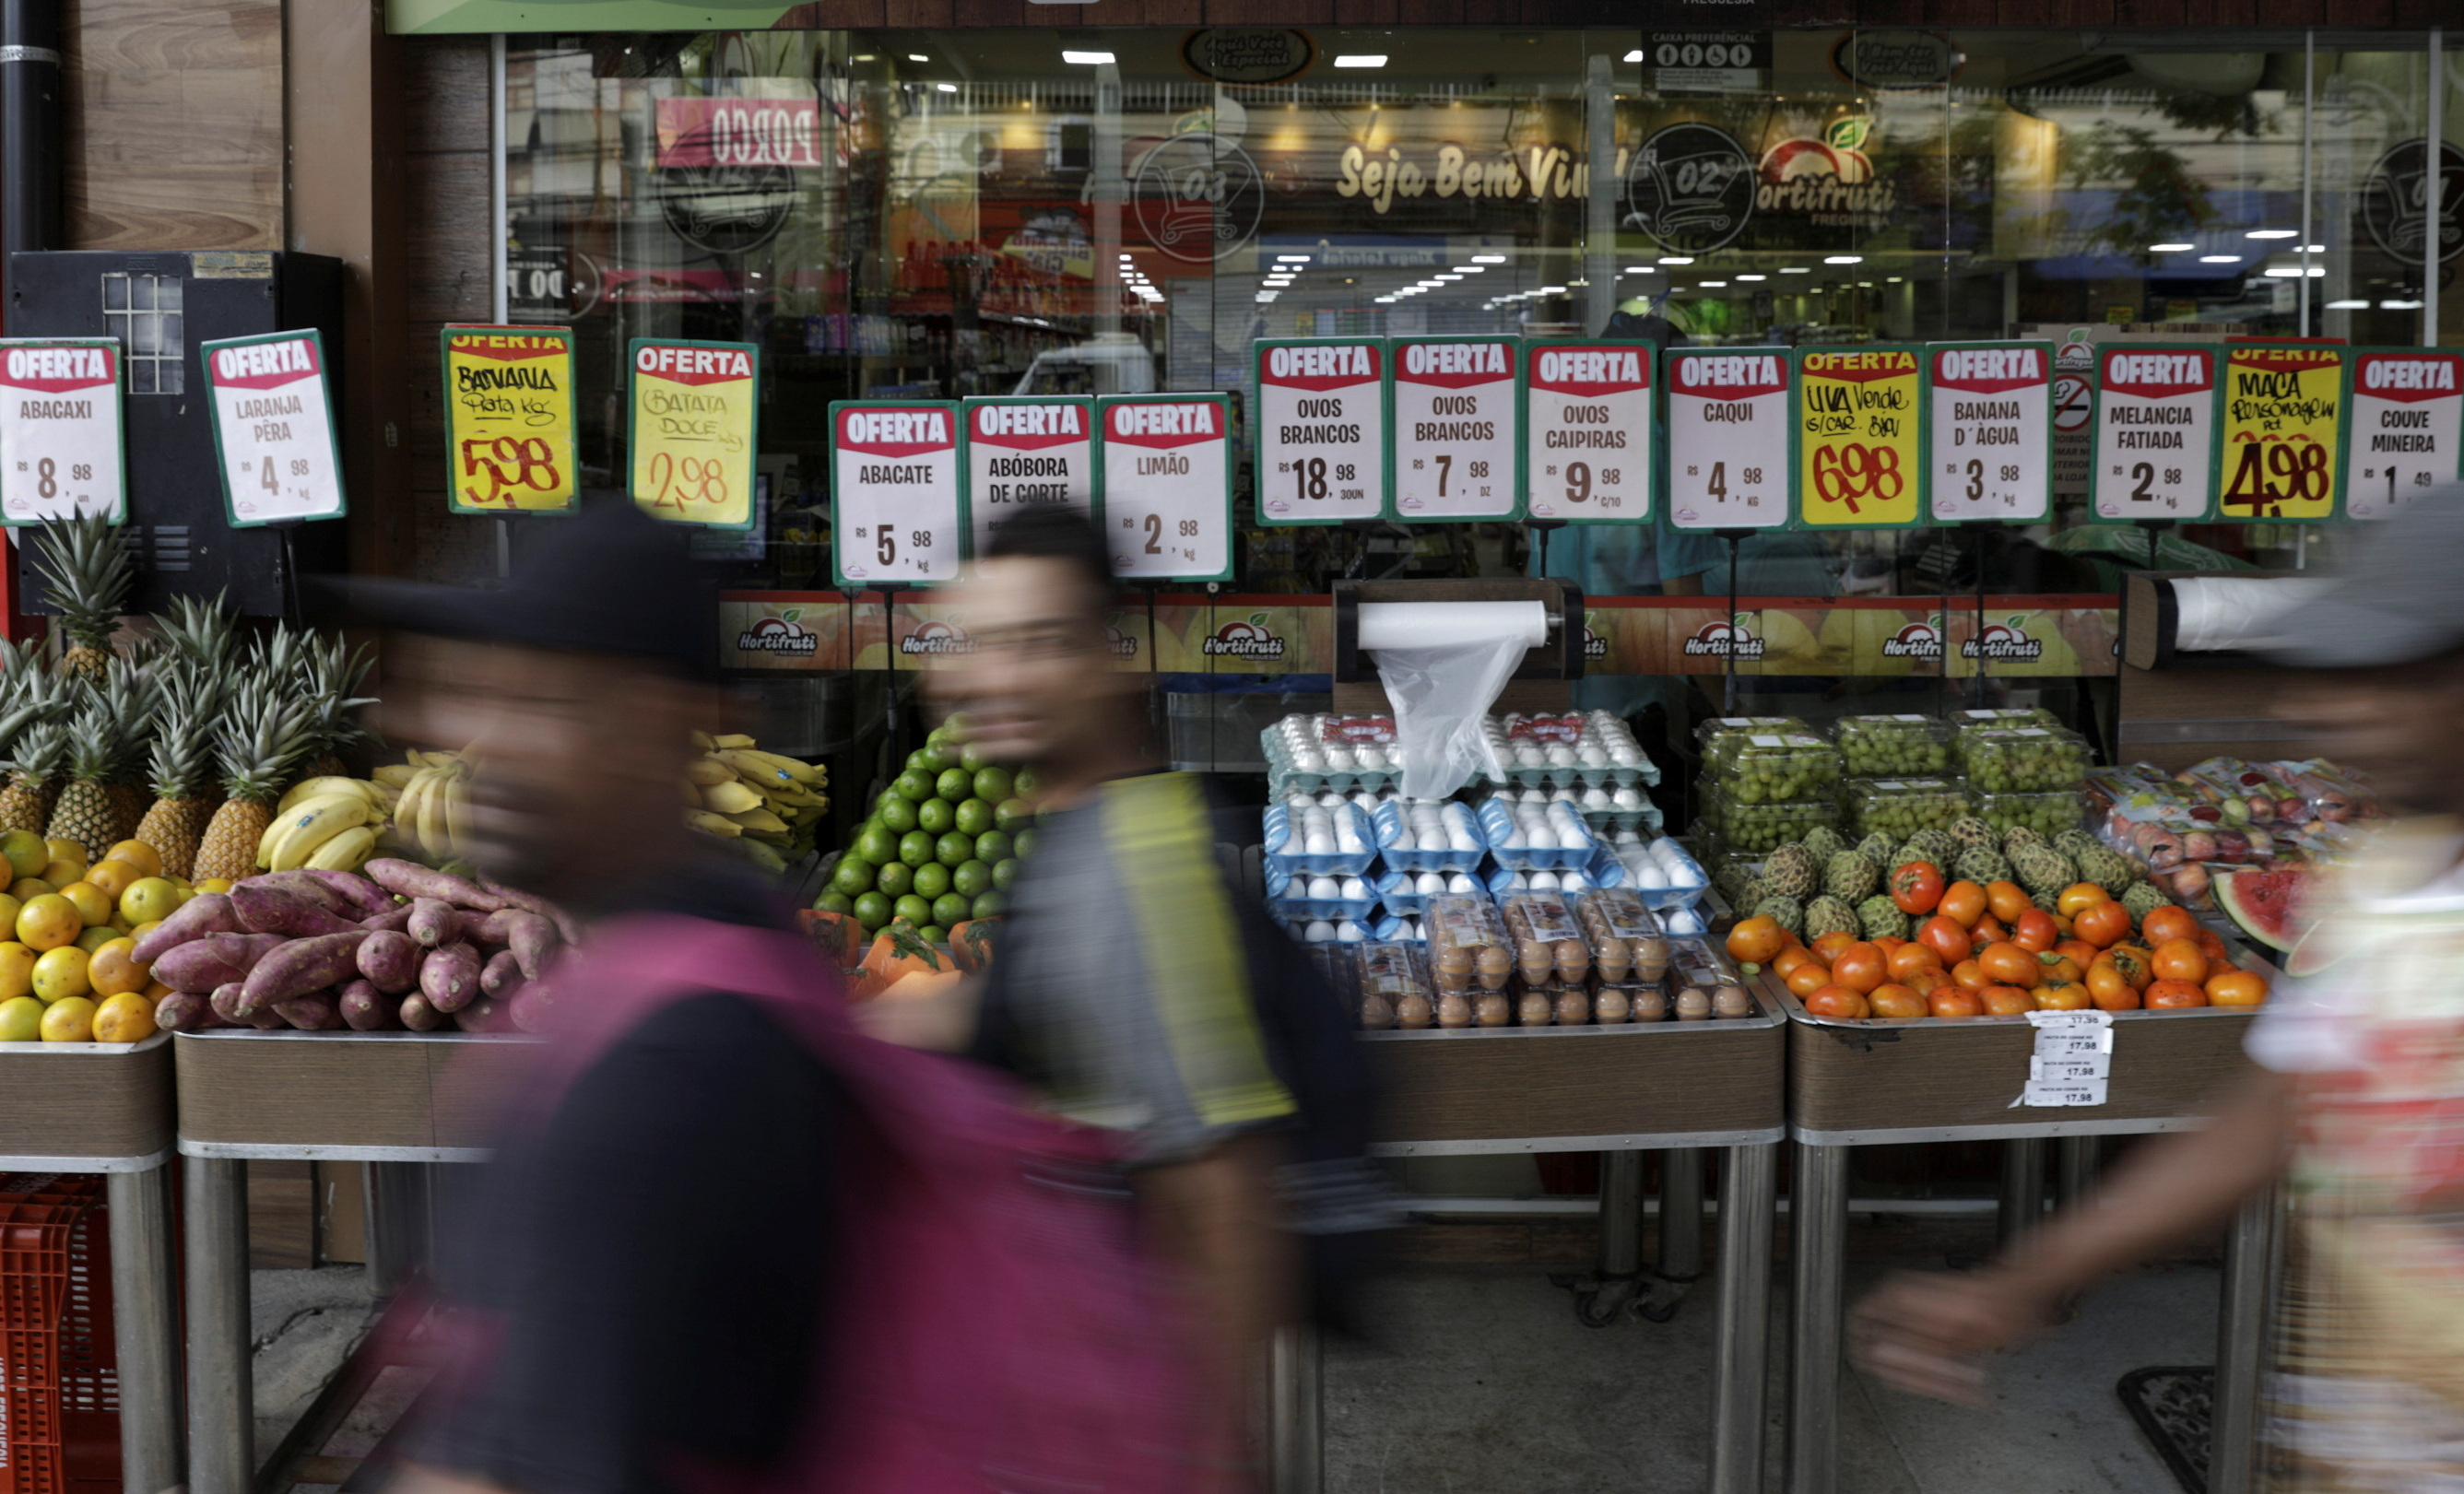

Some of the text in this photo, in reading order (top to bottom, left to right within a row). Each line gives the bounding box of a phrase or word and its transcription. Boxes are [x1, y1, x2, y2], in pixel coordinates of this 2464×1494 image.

[1652, 33, 1683, 42] CAIXA
[1182, 168, 1227, 203] 03
[1337, 144, 1428, 215] Seja
[1435, 145, 1523, 198] Bem
[1676, 160, 1720, 194] 02
[1756, 175, 1896, 210] ortifruti
[7, 347, 108, 380] OFERTA
[218, 338, 312, 380] OFERTA
[636, 346, 752, 376] OFERTA
[1269, 345, 1372, 379] OFERTA
[1406, 343, 1507, 375] OFERTA
[1539, 351, 1642, 383] OFERTA
[1804, 351, 1916, 371] OFERTA
[1941, 349, 2040, 381] OFERTA
[2109, 354, 2205, 385] OFERTA
[1680, 356, 1779, 387] OFERTA
[2364, 359, 2456, 391] OFERTA
[236, 394, 303, 420] LARANJA
[1297, 398, 1342, 418] OVOS
[1432, 395, 1477, 416] OVOS
[1807, 382, 1910, 414] UVA Verde
[20, 400, 92, 420] ABACAXI
[979, 404, 1081, 436] OFERTA
[1114, 403, 1215, 436] OFERTA
[1562, 405, 1609, 424] OVOS
[1704, 403, 1752, 423] CAQUI
[1954, 401, 2021, 421] BANANA
[2110, 406, 2193, 425] MELANCIA
[2381, 410, 2430, 429] COUVE
[253, 419, 292, 443] PÊRA
[658, 418, 719, 434] DOCE
[846, 412, 949, 443] OFERTA
[1280, 423, 1360, 444] BRANCOS
[1415, 420, 1494, 441] BRANCOS
[1546, 429, 1626, 450] CAIPIRAS
[2117, 431, 2183, 450] FATIADA
[2372, 434, 2435, 453] MINEIRA
[859, 465, 933, 484] ABACATE
[989, 453, 1068, 477] ABÓBORA
[1137, 452, 1190, 476] LIMÃO
[990, 482, 1069, 504] DE CORTE
[738, 632, 817, 650] Hortifruti
[1204, 637, 1283, 654] Hortifruti
[2069, 1042, 2096, 1051] 17,98
[2067, 1068, 2094, 1076] 17,98
[2065, 1094, 2093, 1102] 17,98
